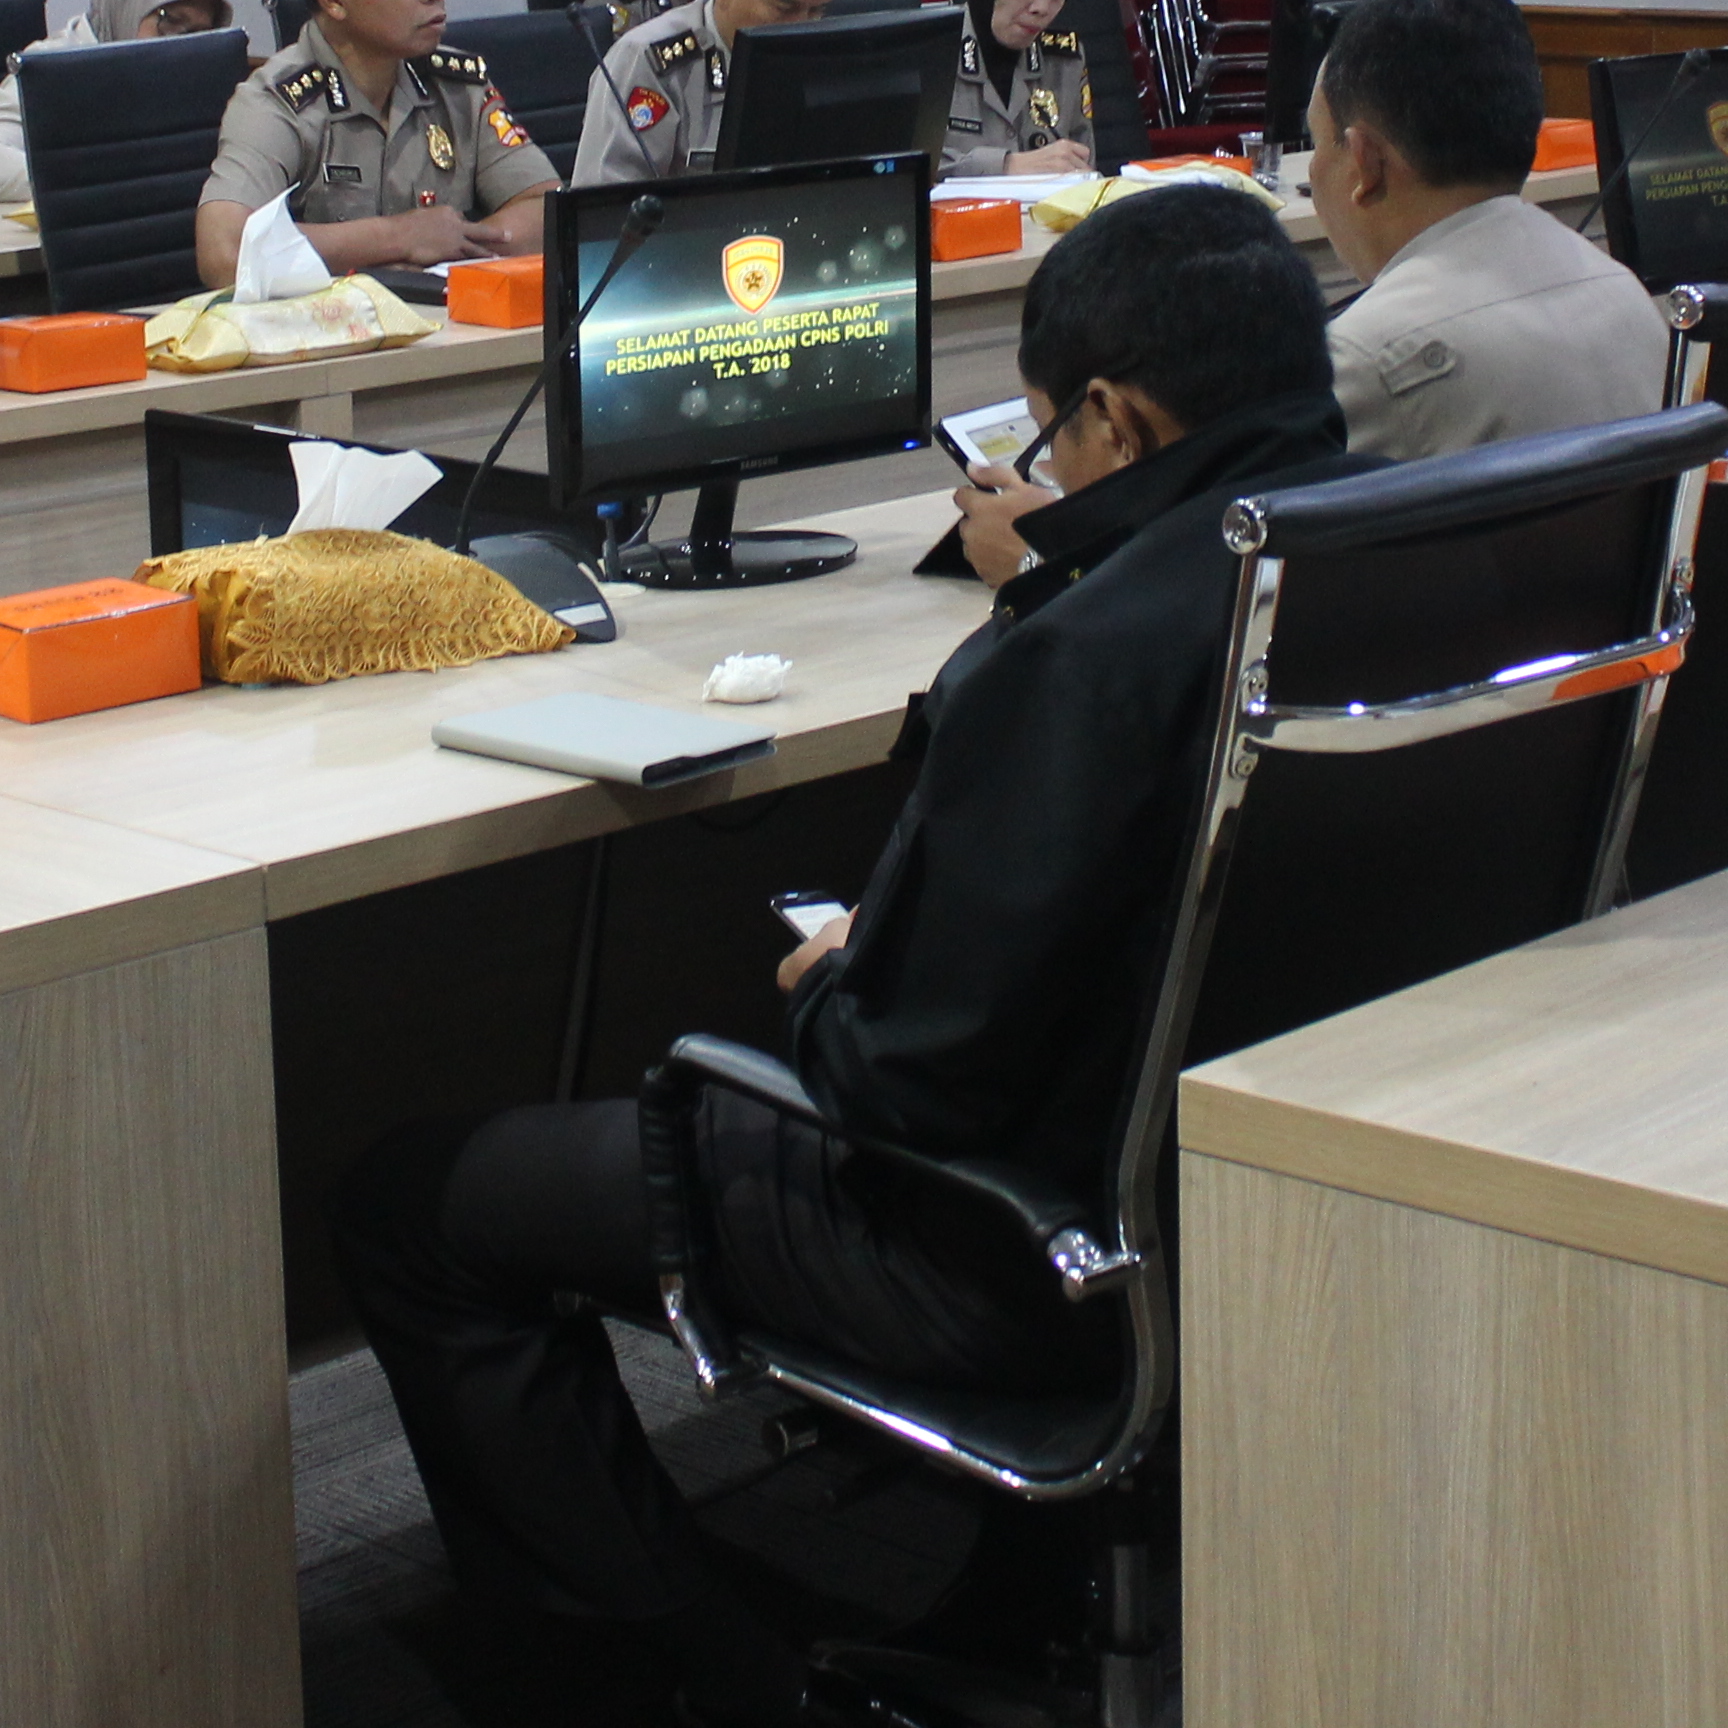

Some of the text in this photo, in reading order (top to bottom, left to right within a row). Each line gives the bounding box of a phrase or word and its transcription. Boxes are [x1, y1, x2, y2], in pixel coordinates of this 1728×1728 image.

[606, 320, 888, 376] PERSIAPAN PENGADAAN CPNS POLRI
[616, 303, 880, 355] SELAMAT DATANG PESERTA RAPAT
[714, 353, 791, 379] T.A. 2018
